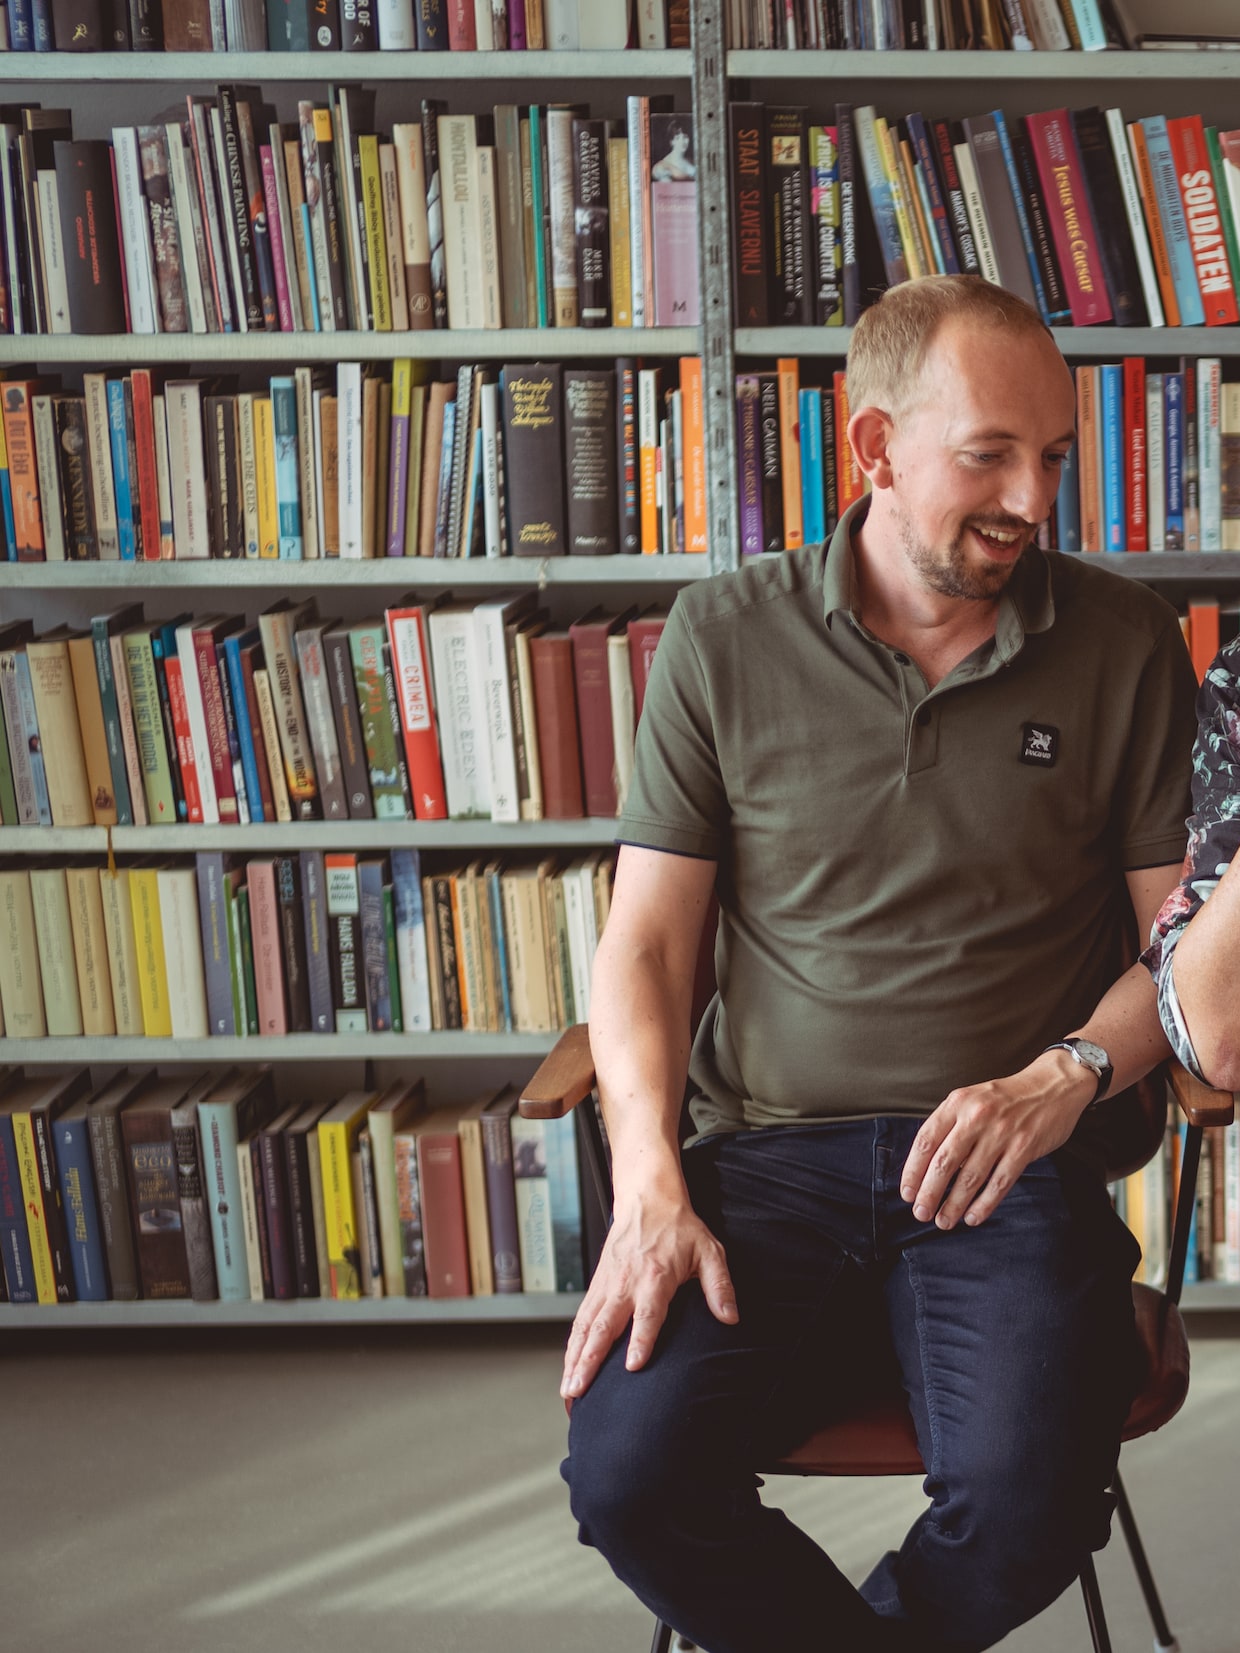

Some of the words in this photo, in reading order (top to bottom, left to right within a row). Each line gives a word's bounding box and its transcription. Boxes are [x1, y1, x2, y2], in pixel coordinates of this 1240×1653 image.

[226, 133, 242, 188] CHINESE
[579, 131, 591, 203] GRAVEYARD
[737, 128, 759, 176] STAAT
[817, 135, 834, 173] AFRICA
[782, 176, 792, 240] NEDERLAND
[818, 177, 833, 188] IS
[819, 190, 833, 214] NOT
[1052, 163, 1073, 206] Jesus
[233, 189, 249, 247] PAINTING
[739, 190, 761, 276] SLAVERNIJ
[949, 190, 968, 233] ANARCHY'S
[959, 234, 976, 269] COSSACK
[1063, 207, 1082, 238] was
[1180, 169, 1231, 293] SOLDATEN
[582, 248, 593, 281] DASH
[592, 248, 603, 280] MIKE
[819, 226, 837, 279] COUNTRY
[1069, 239, 1094, 294] Caesar
[762, 382, 777, 416] NEIL
[762, 418, 779, 480] GAIMAN
[1133, 450, 1142, 470] van
[275, 659, 294, 697] HISTORY
[285, 719, 299, 736] END
[359, 635, 384, 715] GERMANIA
[403, 665, 425, 722] CRIMEA
[451, 636, 472, 723] ELECTRIC
[491, 679, 508, 743] Beverwijck
[459, 728, 477, 780] EDEN
[338, 916, 353, 952] HANS
[341, 953, 356, 1005] FALLADA
[90, 1115, 102, 1138] The
